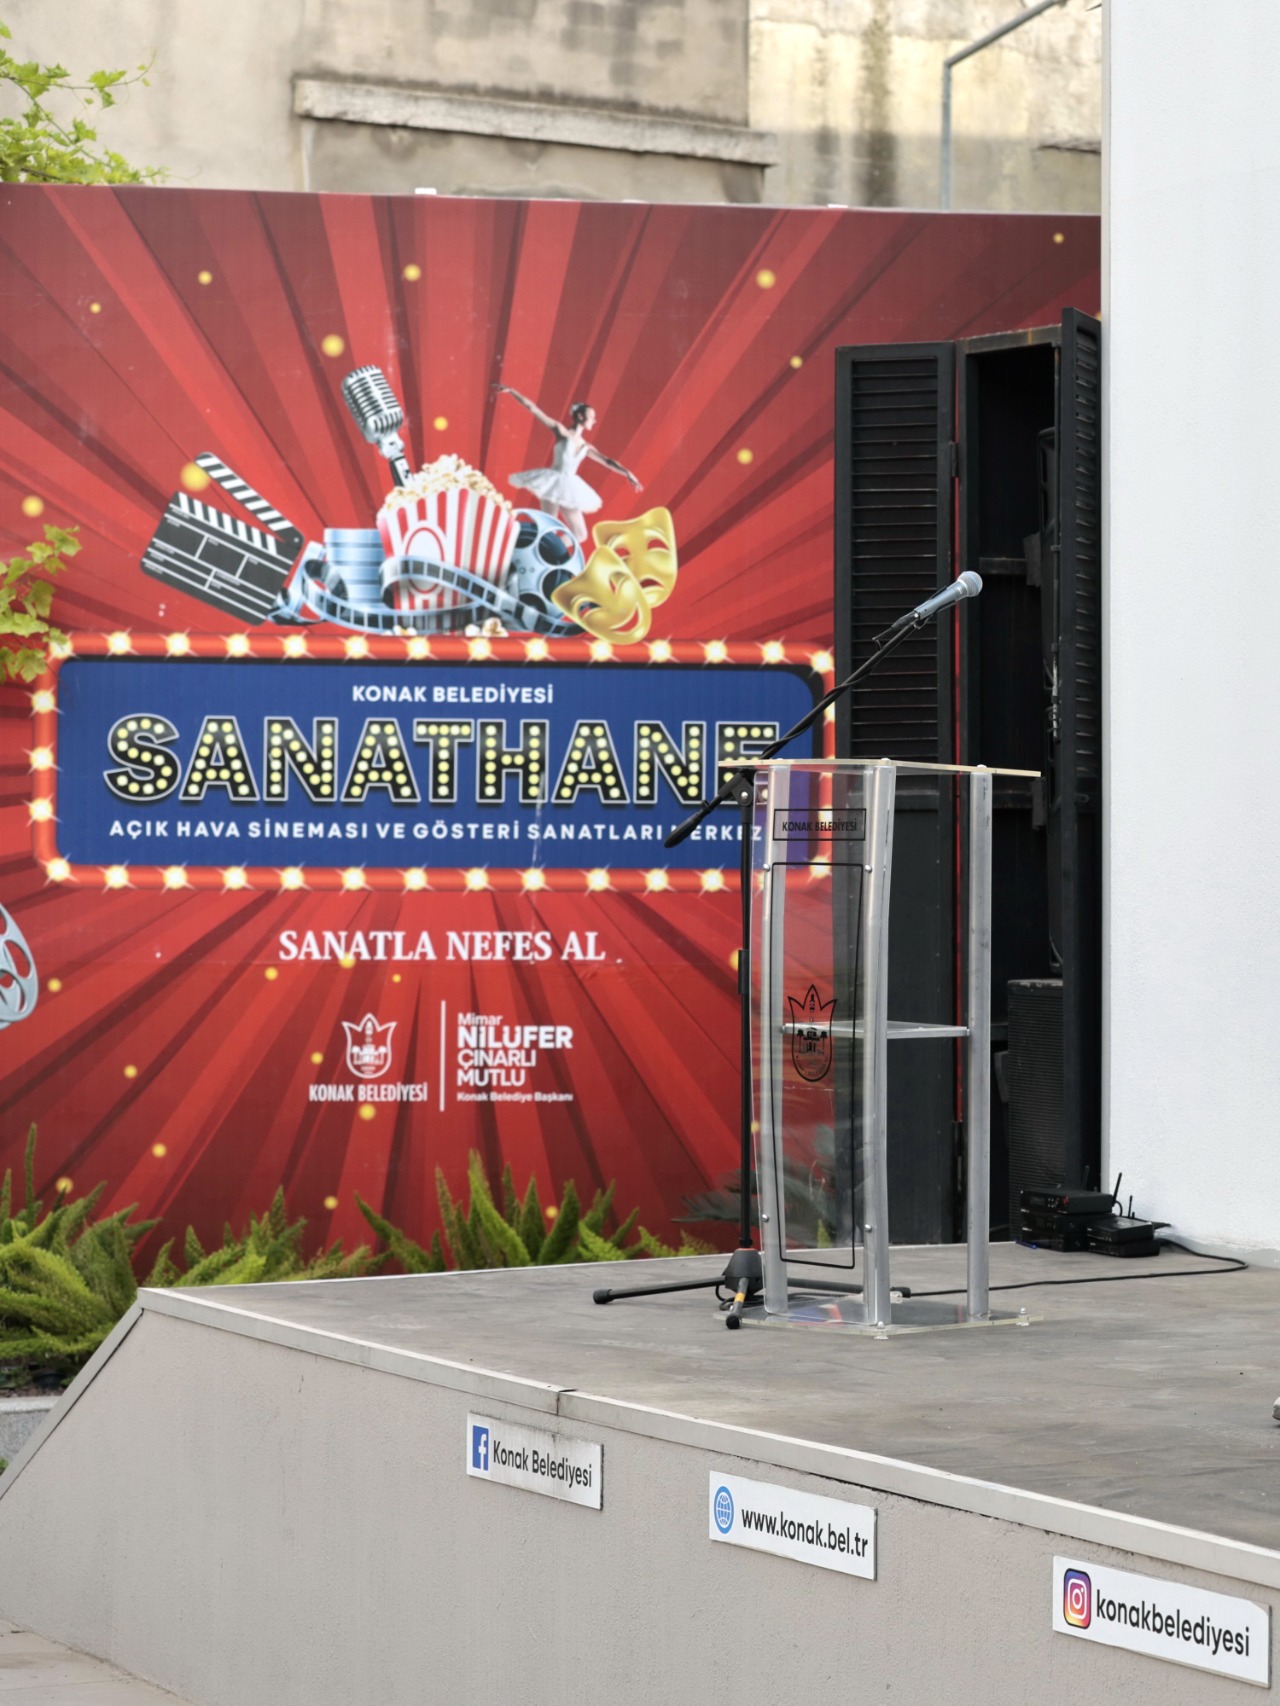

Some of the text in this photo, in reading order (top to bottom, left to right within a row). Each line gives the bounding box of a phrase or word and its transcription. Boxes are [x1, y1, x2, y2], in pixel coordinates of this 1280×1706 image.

[352, 683, 554, 704] KONAK BELEDİYESİ
[103, 712, 780, 804] SANATHANE
[109, 820, 169, 840] AÇIK
[177, 820, 240, 838] HAVA
[248, 818, 368, 839] SİNEMASI
[376, 822, 405, 839] VE
[413, 820, 520, 840] GÖSTERİ
[527, 823, 663, 841] SANATLARI
[782, 818, 857, 832] KONAK BELEDİYESİ
[278, 930, 607, 962] SANATLA NEFES AL
[457, 1012, 503, 1027] Mimar
[457, 1048, 537, 1070] ÇINARLI
[457, 1068, 526, 1087] MUTLU
[309, 1081, 428, 1102] KONAK BELEDİYESİ
[457, 1091, 488, 1103] Konak
[490, 1091, 532, 1104] Belediye
[493, 1439, 529, 1471] Konak
[532, 1449, 592, 1489] Belediyesi
[741, 1506, 869, 1558] www.konak.bel.tr
[1096, 1588, 1250, 1657] konakbelediyesi
